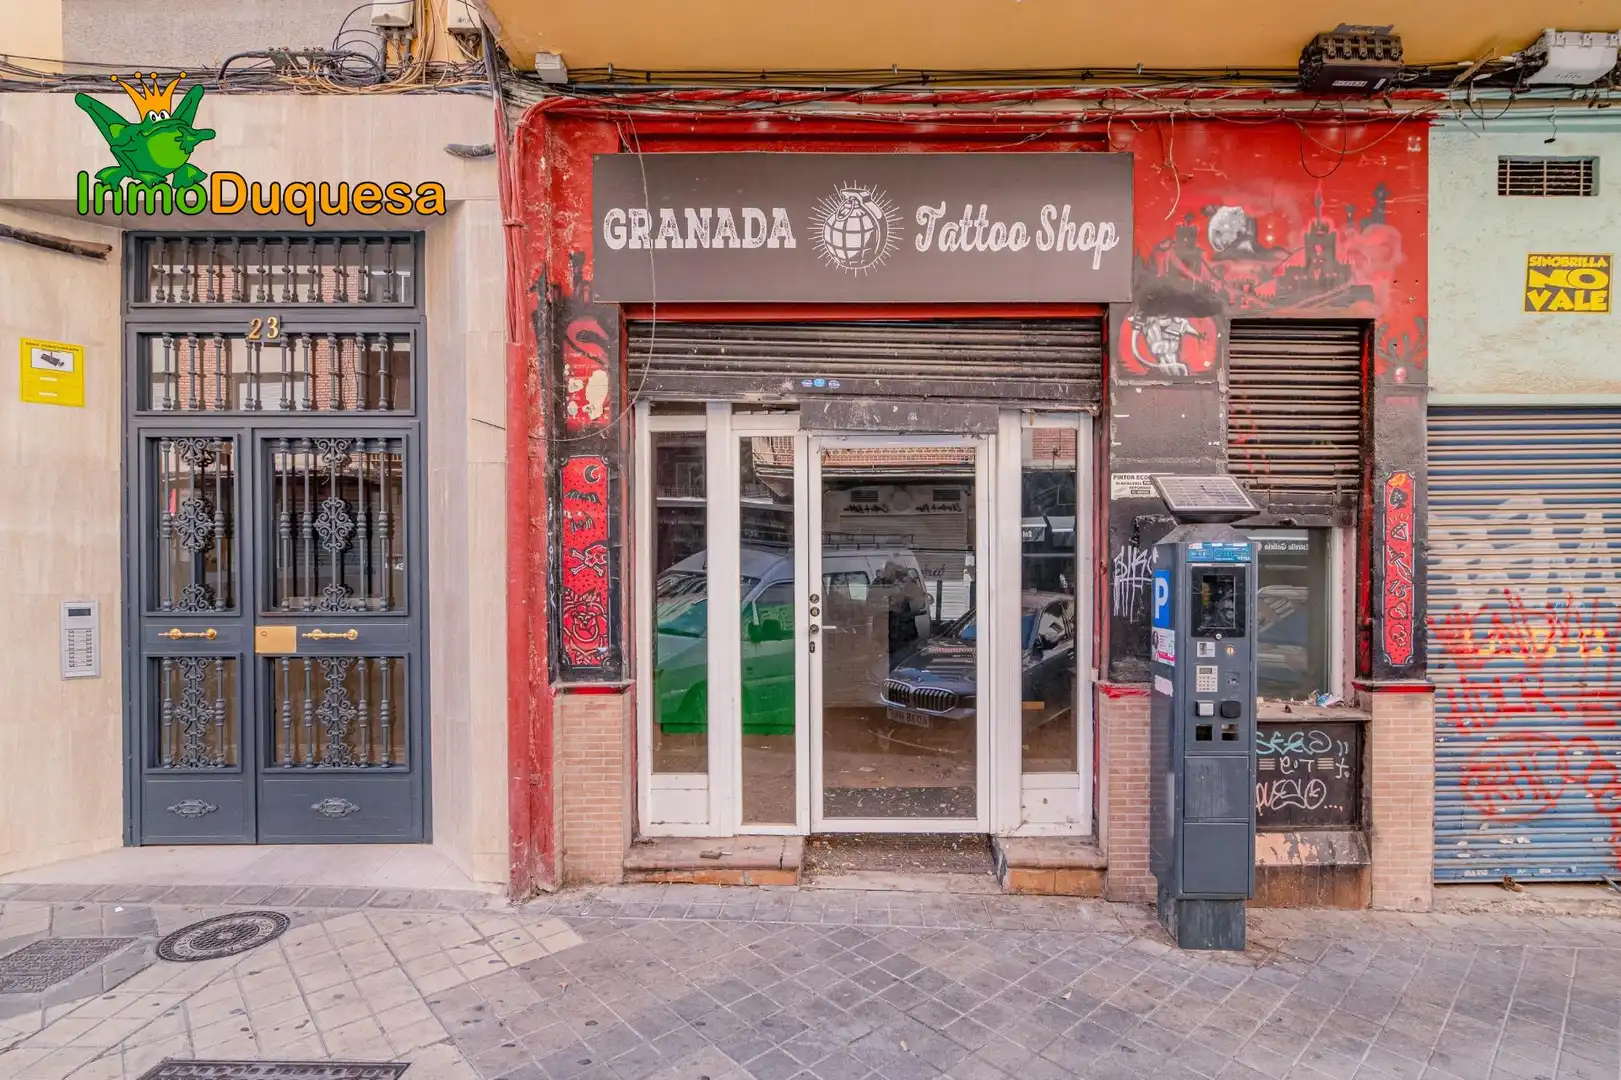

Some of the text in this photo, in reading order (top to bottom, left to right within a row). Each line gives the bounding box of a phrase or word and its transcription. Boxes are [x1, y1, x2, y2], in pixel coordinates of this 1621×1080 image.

[603, 201, 1120, 270] GRANADA Tattoo Shop
[1528, 268, 1609, 289] NO
[1527, 288, 1608, 311] VALE
[248, 316, 279, 340] 23
[1155, 577, 1169, 619] P
